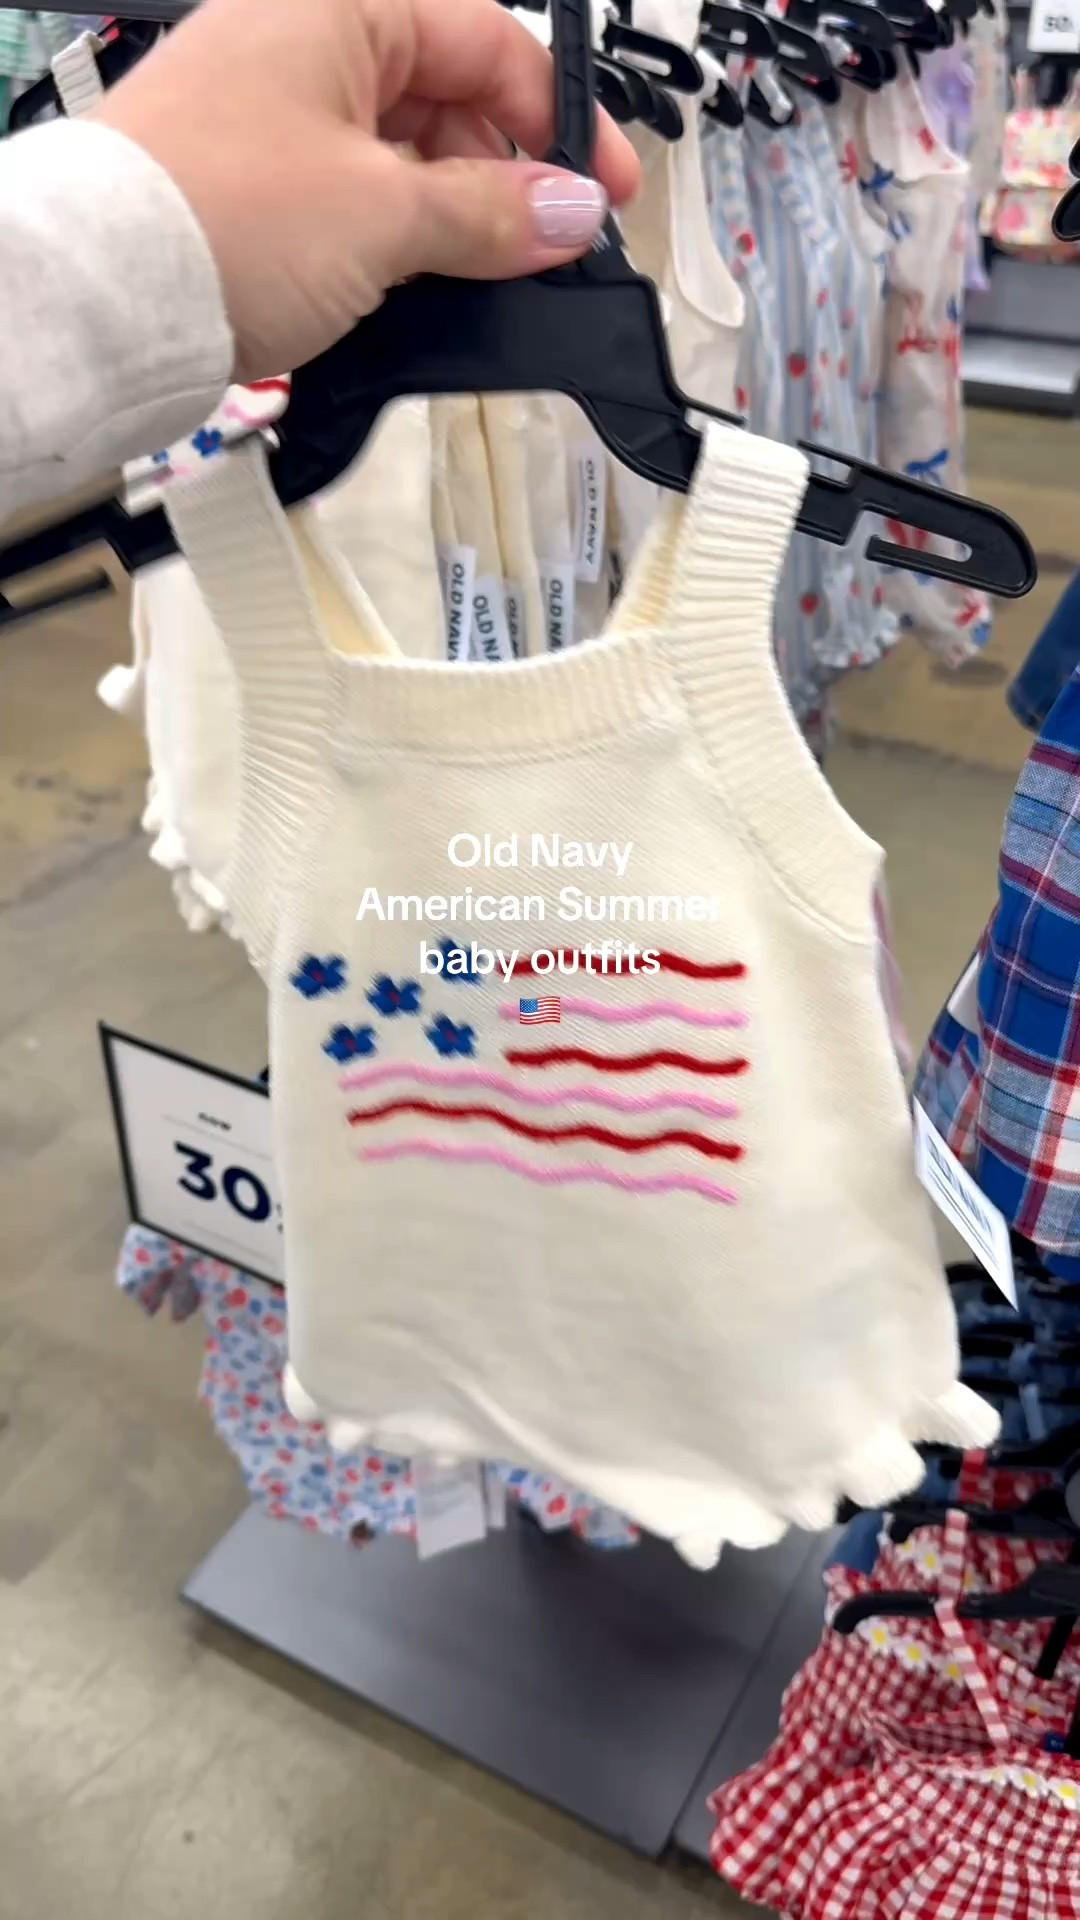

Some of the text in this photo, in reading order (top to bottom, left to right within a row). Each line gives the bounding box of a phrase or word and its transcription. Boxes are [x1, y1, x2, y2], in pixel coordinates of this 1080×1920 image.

[451, 562, 465, 605] OLD
[549, 579, 563, 616] OLD
[473, 595, 494, 634] OLD
[174, 1140, 272, 1224] 30
